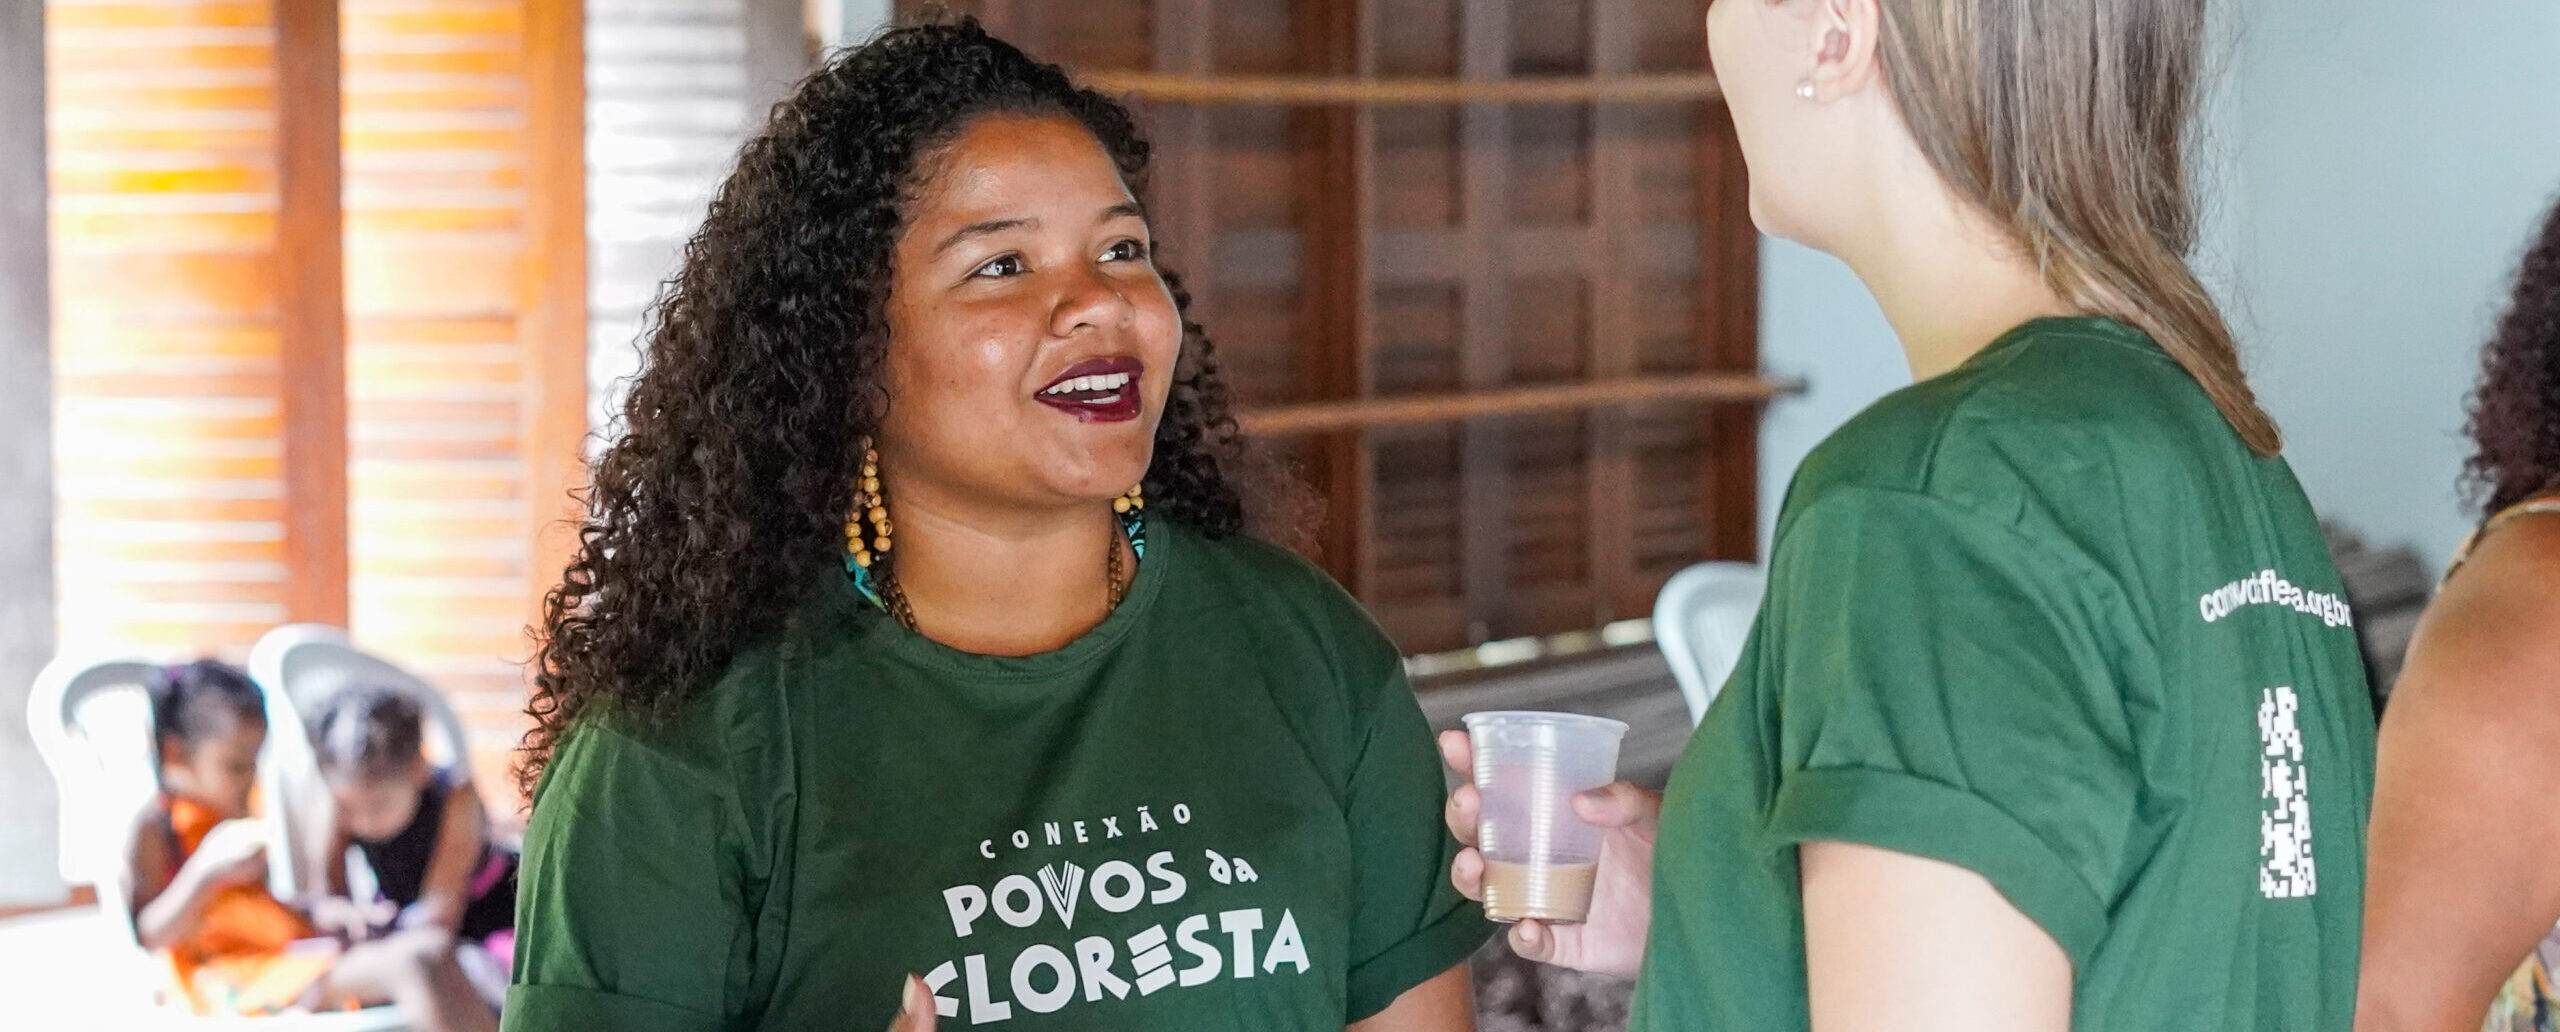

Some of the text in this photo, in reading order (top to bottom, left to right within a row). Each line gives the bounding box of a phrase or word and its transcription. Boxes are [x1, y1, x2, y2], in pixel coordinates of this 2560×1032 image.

[980, 803, 1191, 859] CONEXÃO
[942, 849, 1259, 938] POVOS da
